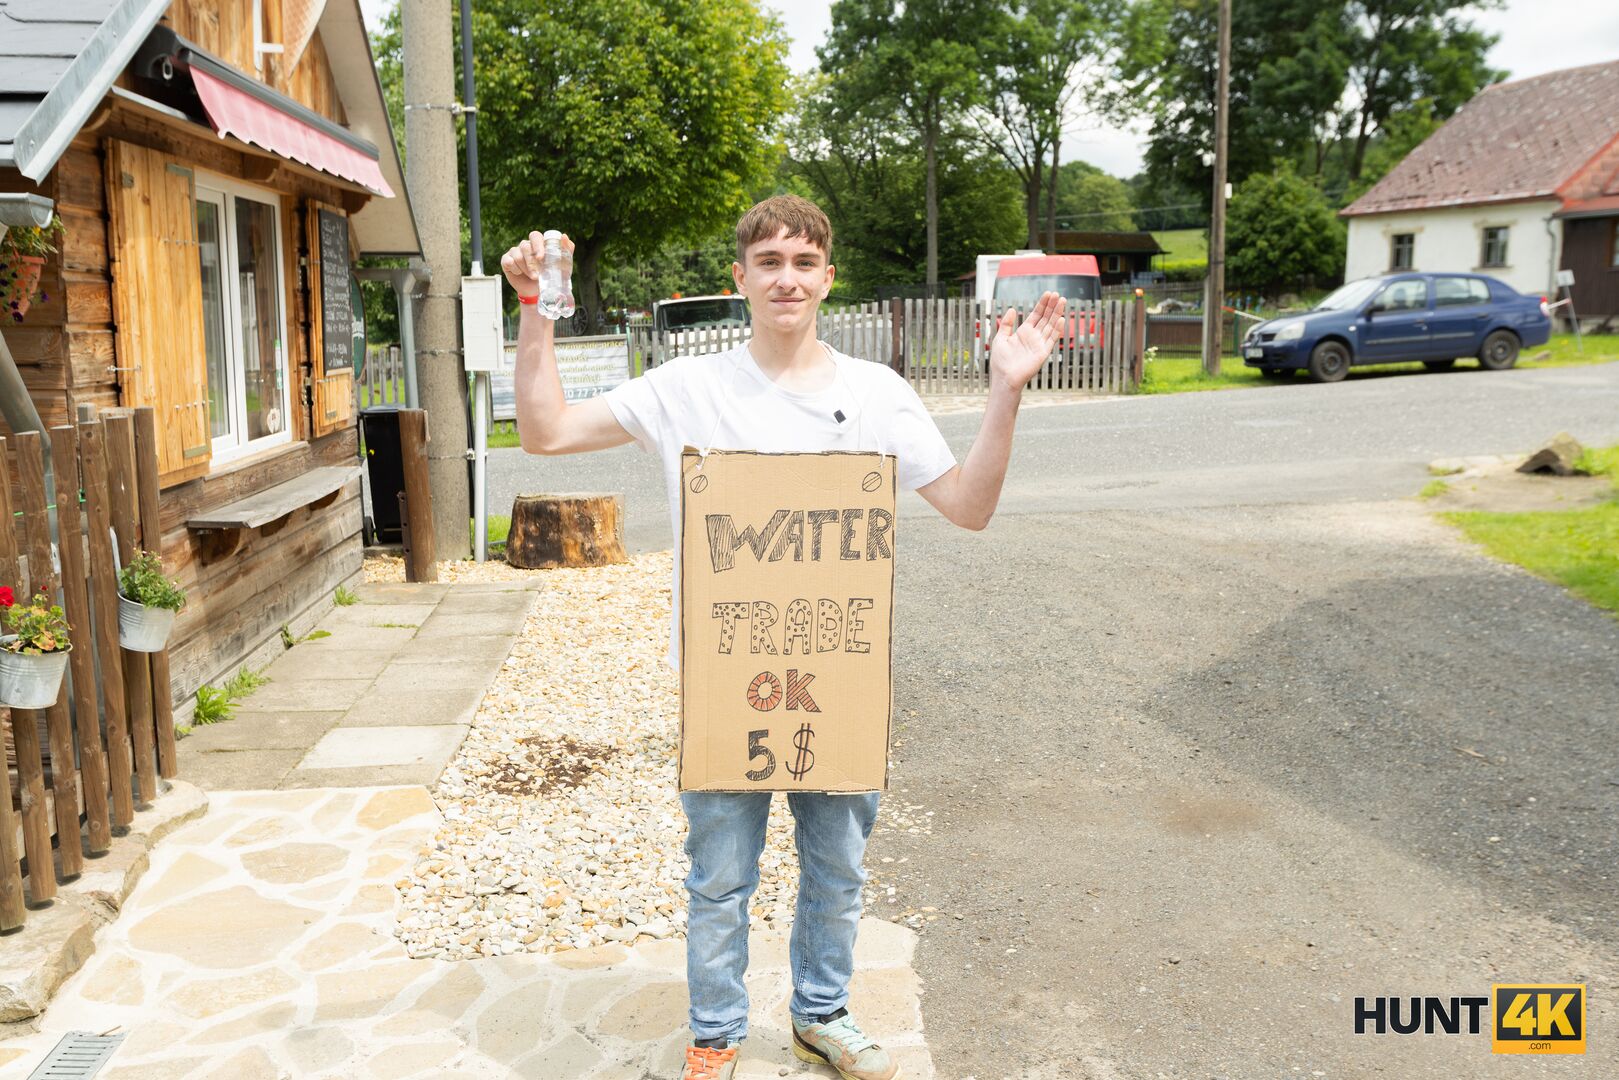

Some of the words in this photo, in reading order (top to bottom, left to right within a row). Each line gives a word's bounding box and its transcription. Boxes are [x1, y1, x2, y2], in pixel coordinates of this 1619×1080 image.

[705, 508, 892, 573] WATER
[712, 598, 874, 655] TRADE
[746, 668, 822, 713] OK
